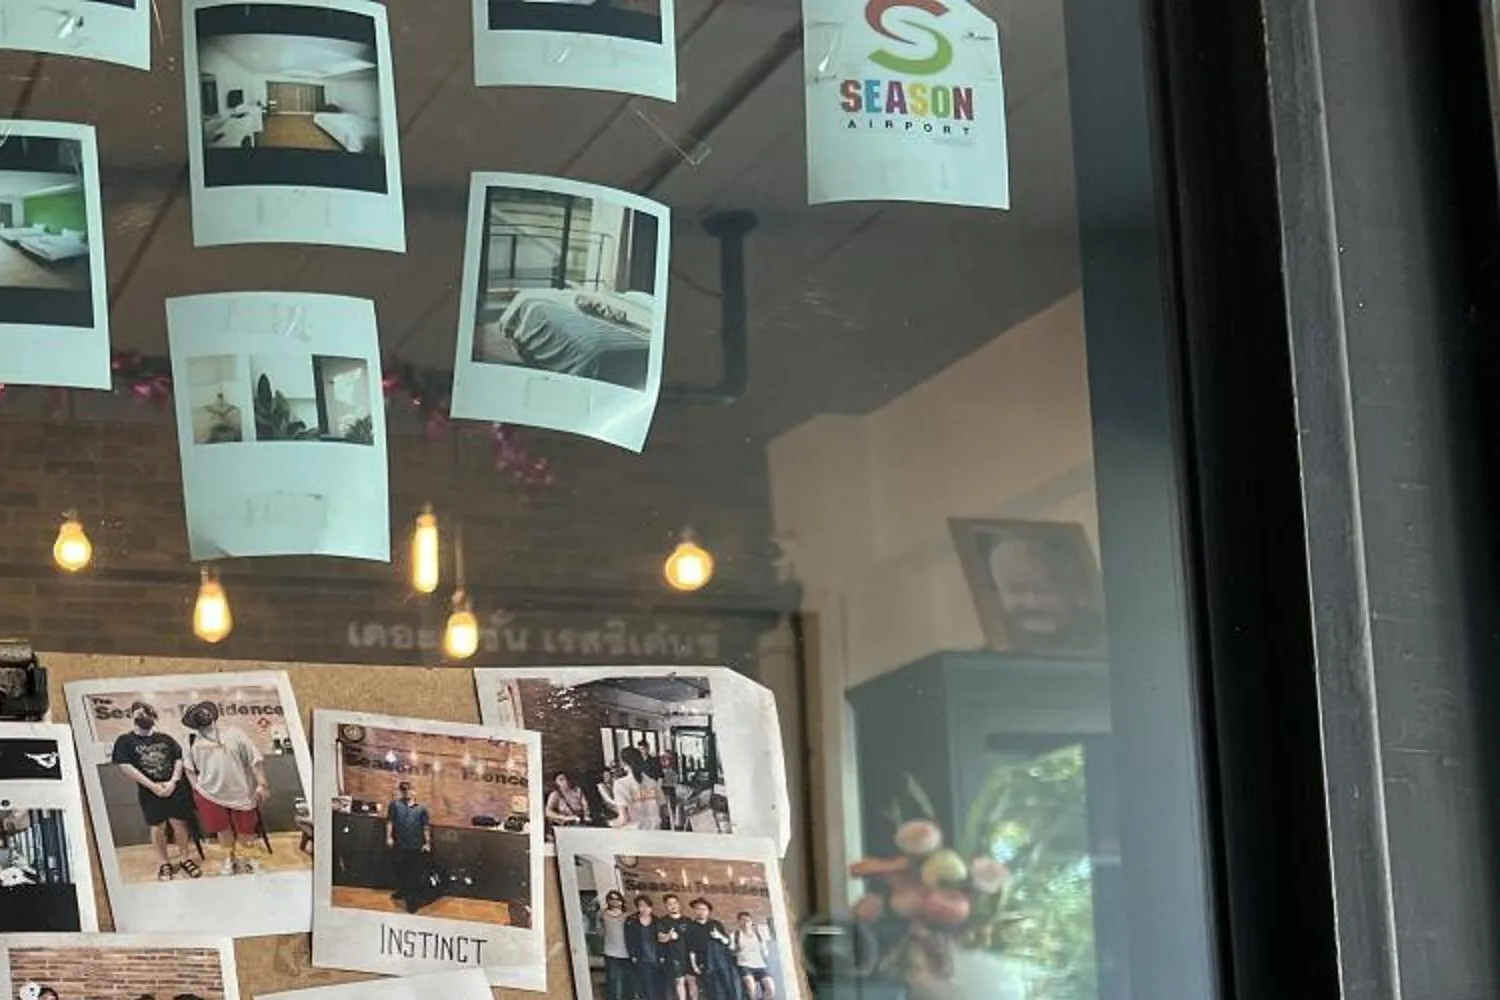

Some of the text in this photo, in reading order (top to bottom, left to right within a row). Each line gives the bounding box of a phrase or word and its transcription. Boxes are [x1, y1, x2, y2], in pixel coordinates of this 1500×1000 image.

[840, 79, 974, 121] SEASON
[847, 120, 970, 135] AIRPORT
[379, 924, 488, 965] INSTINCT
